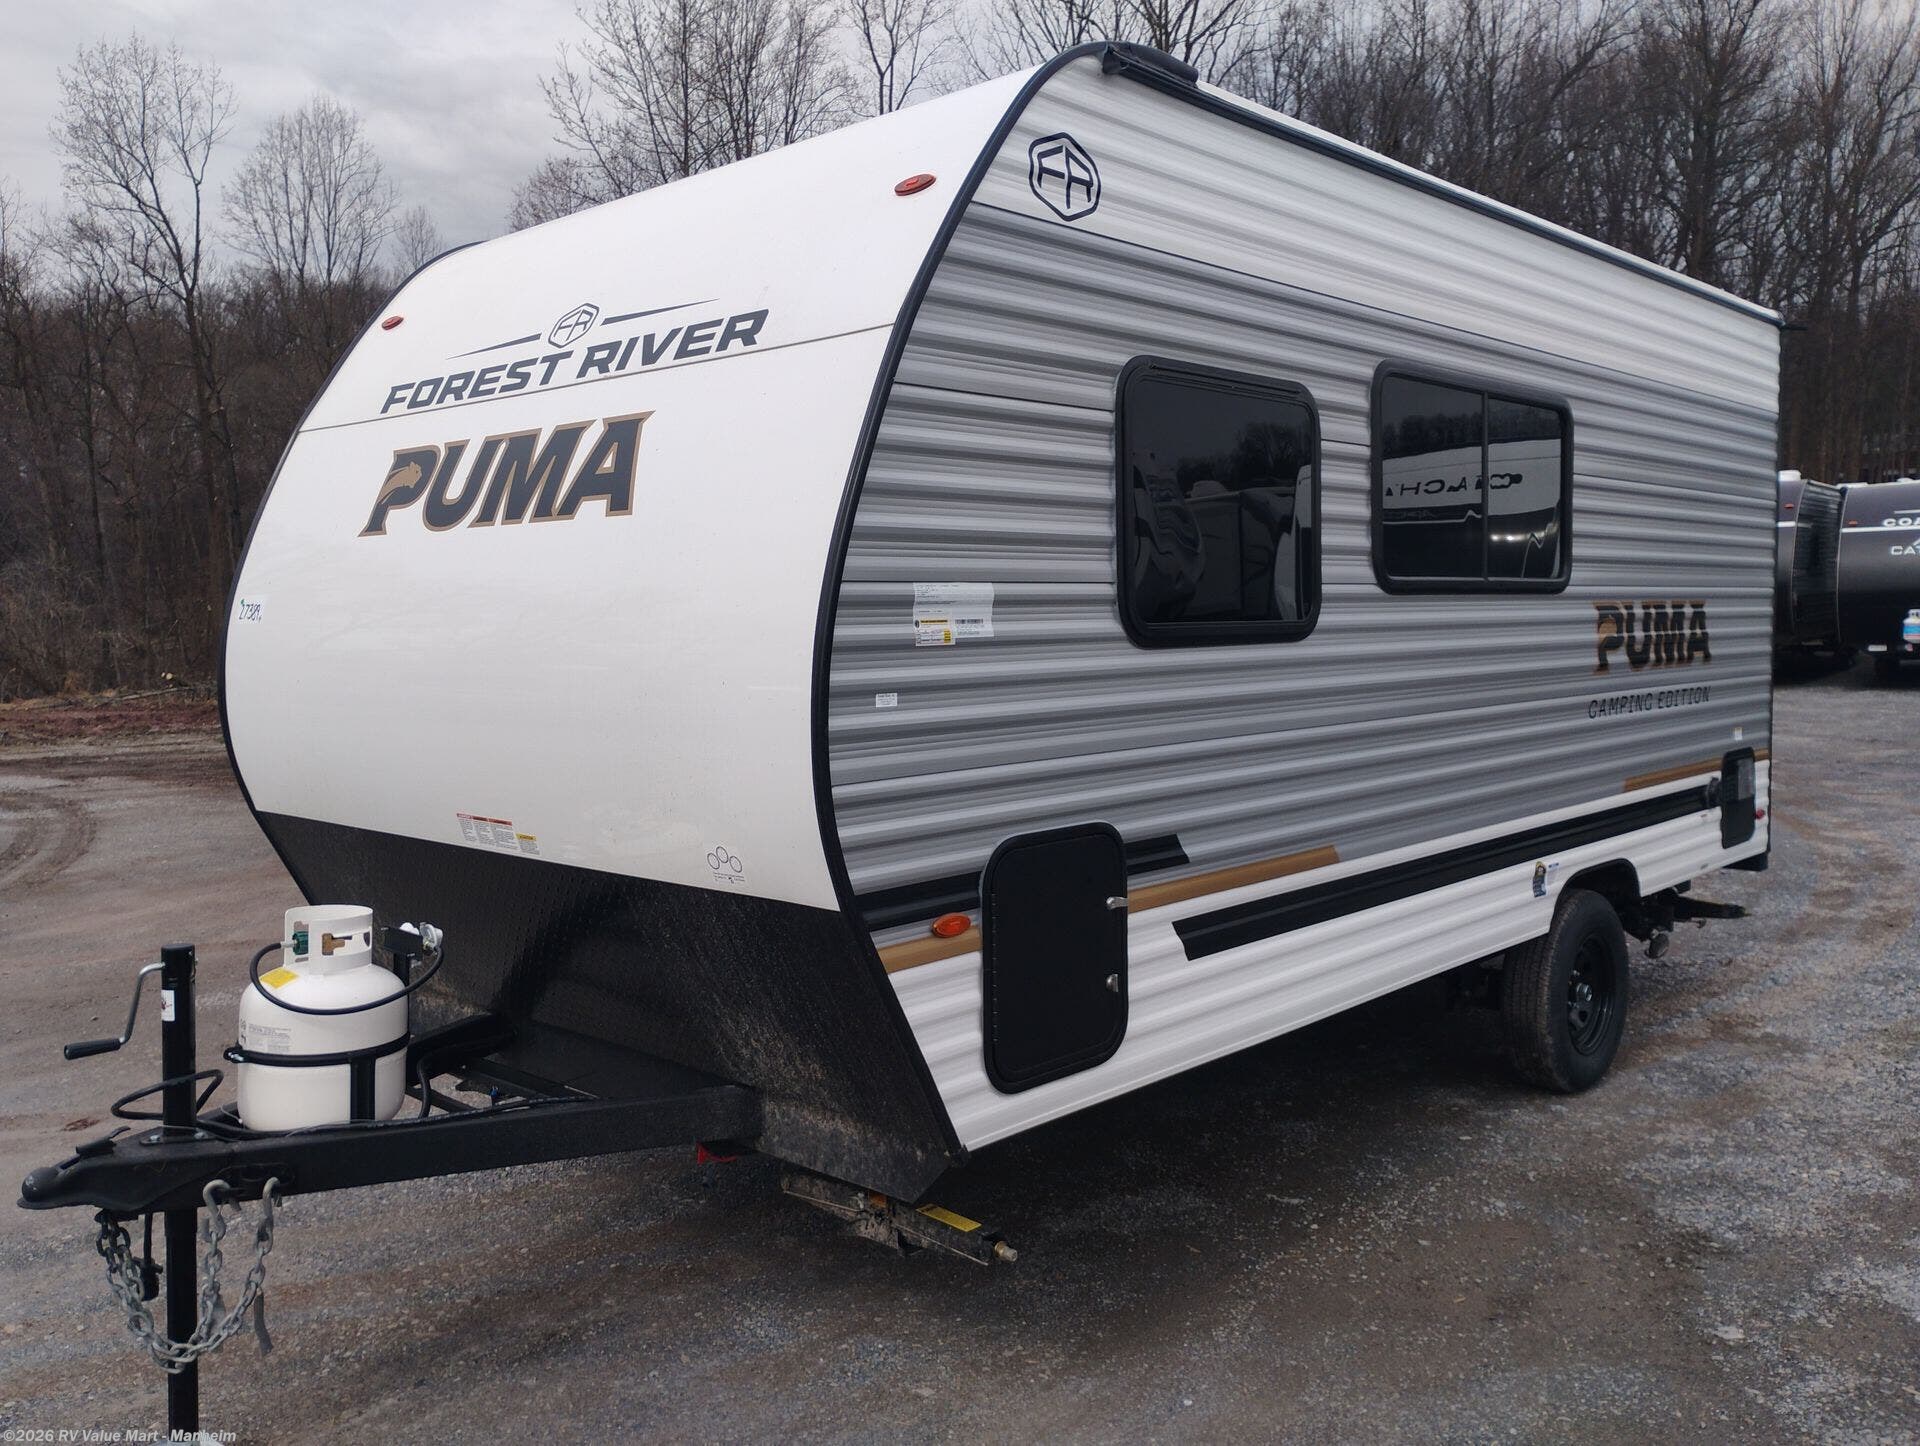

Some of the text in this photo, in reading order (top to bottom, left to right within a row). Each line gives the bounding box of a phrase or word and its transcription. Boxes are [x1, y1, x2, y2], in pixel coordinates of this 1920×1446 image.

[380, 309, 769, 414] FOREST RIVER
[357, 410, 656, 537] PUMA
[1593, 600, 1711, 675] PUMA
[1588, 685, 1711, 719] CAMPING EDITION
